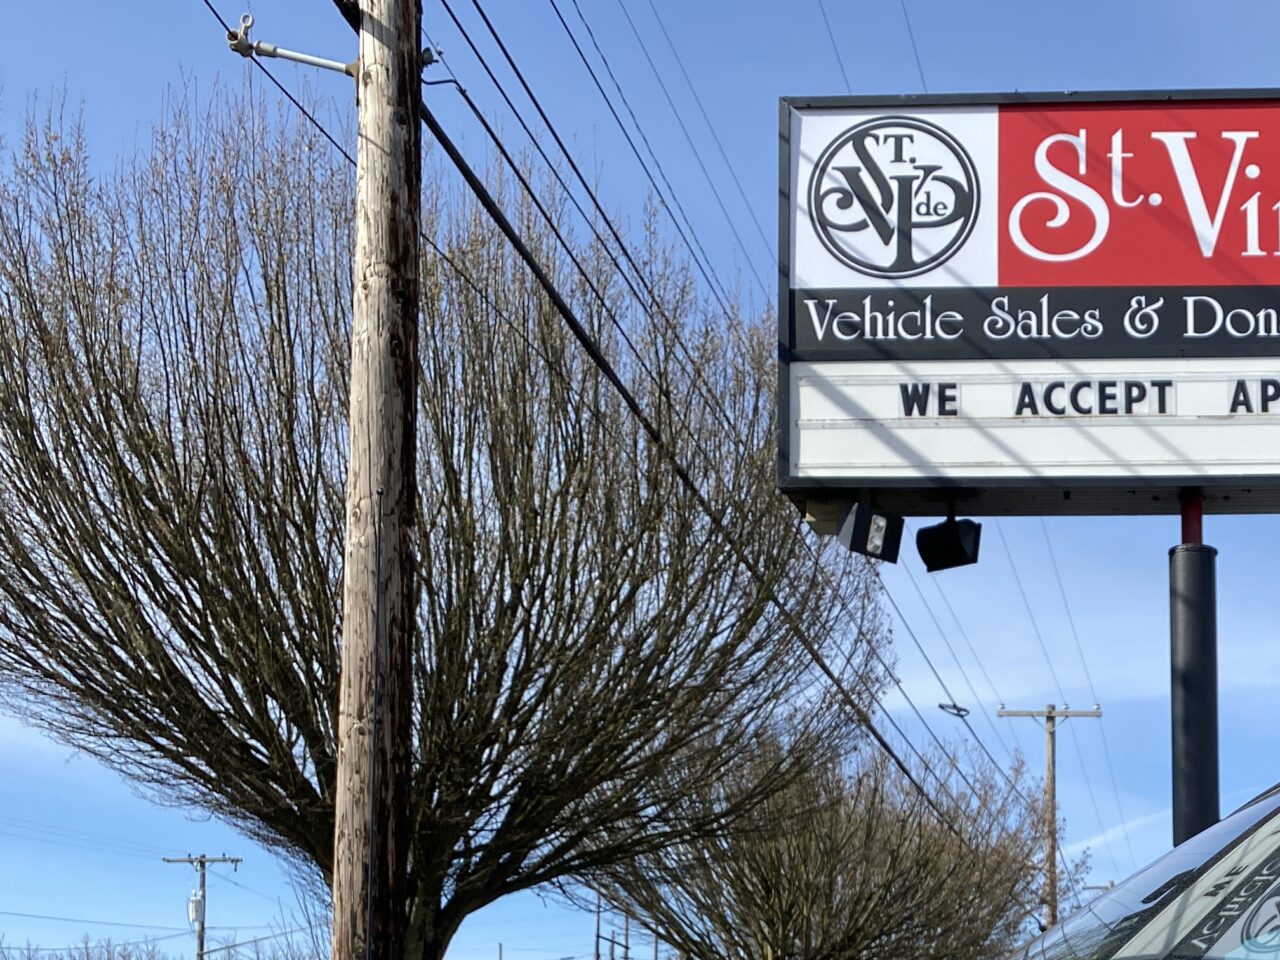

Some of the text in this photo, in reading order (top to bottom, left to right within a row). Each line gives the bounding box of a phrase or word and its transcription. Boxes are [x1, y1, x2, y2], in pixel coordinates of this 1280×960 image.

[1009, 128, 1163, 263] St.
[804, 294, 964, 341] Vehicle
[983, 293, 1103, 340] Sales
[1123, 295, 1164, 338] &
[900, 381, 958, 416] WE
[1015, 380, 1173, 415] ACCEPT
